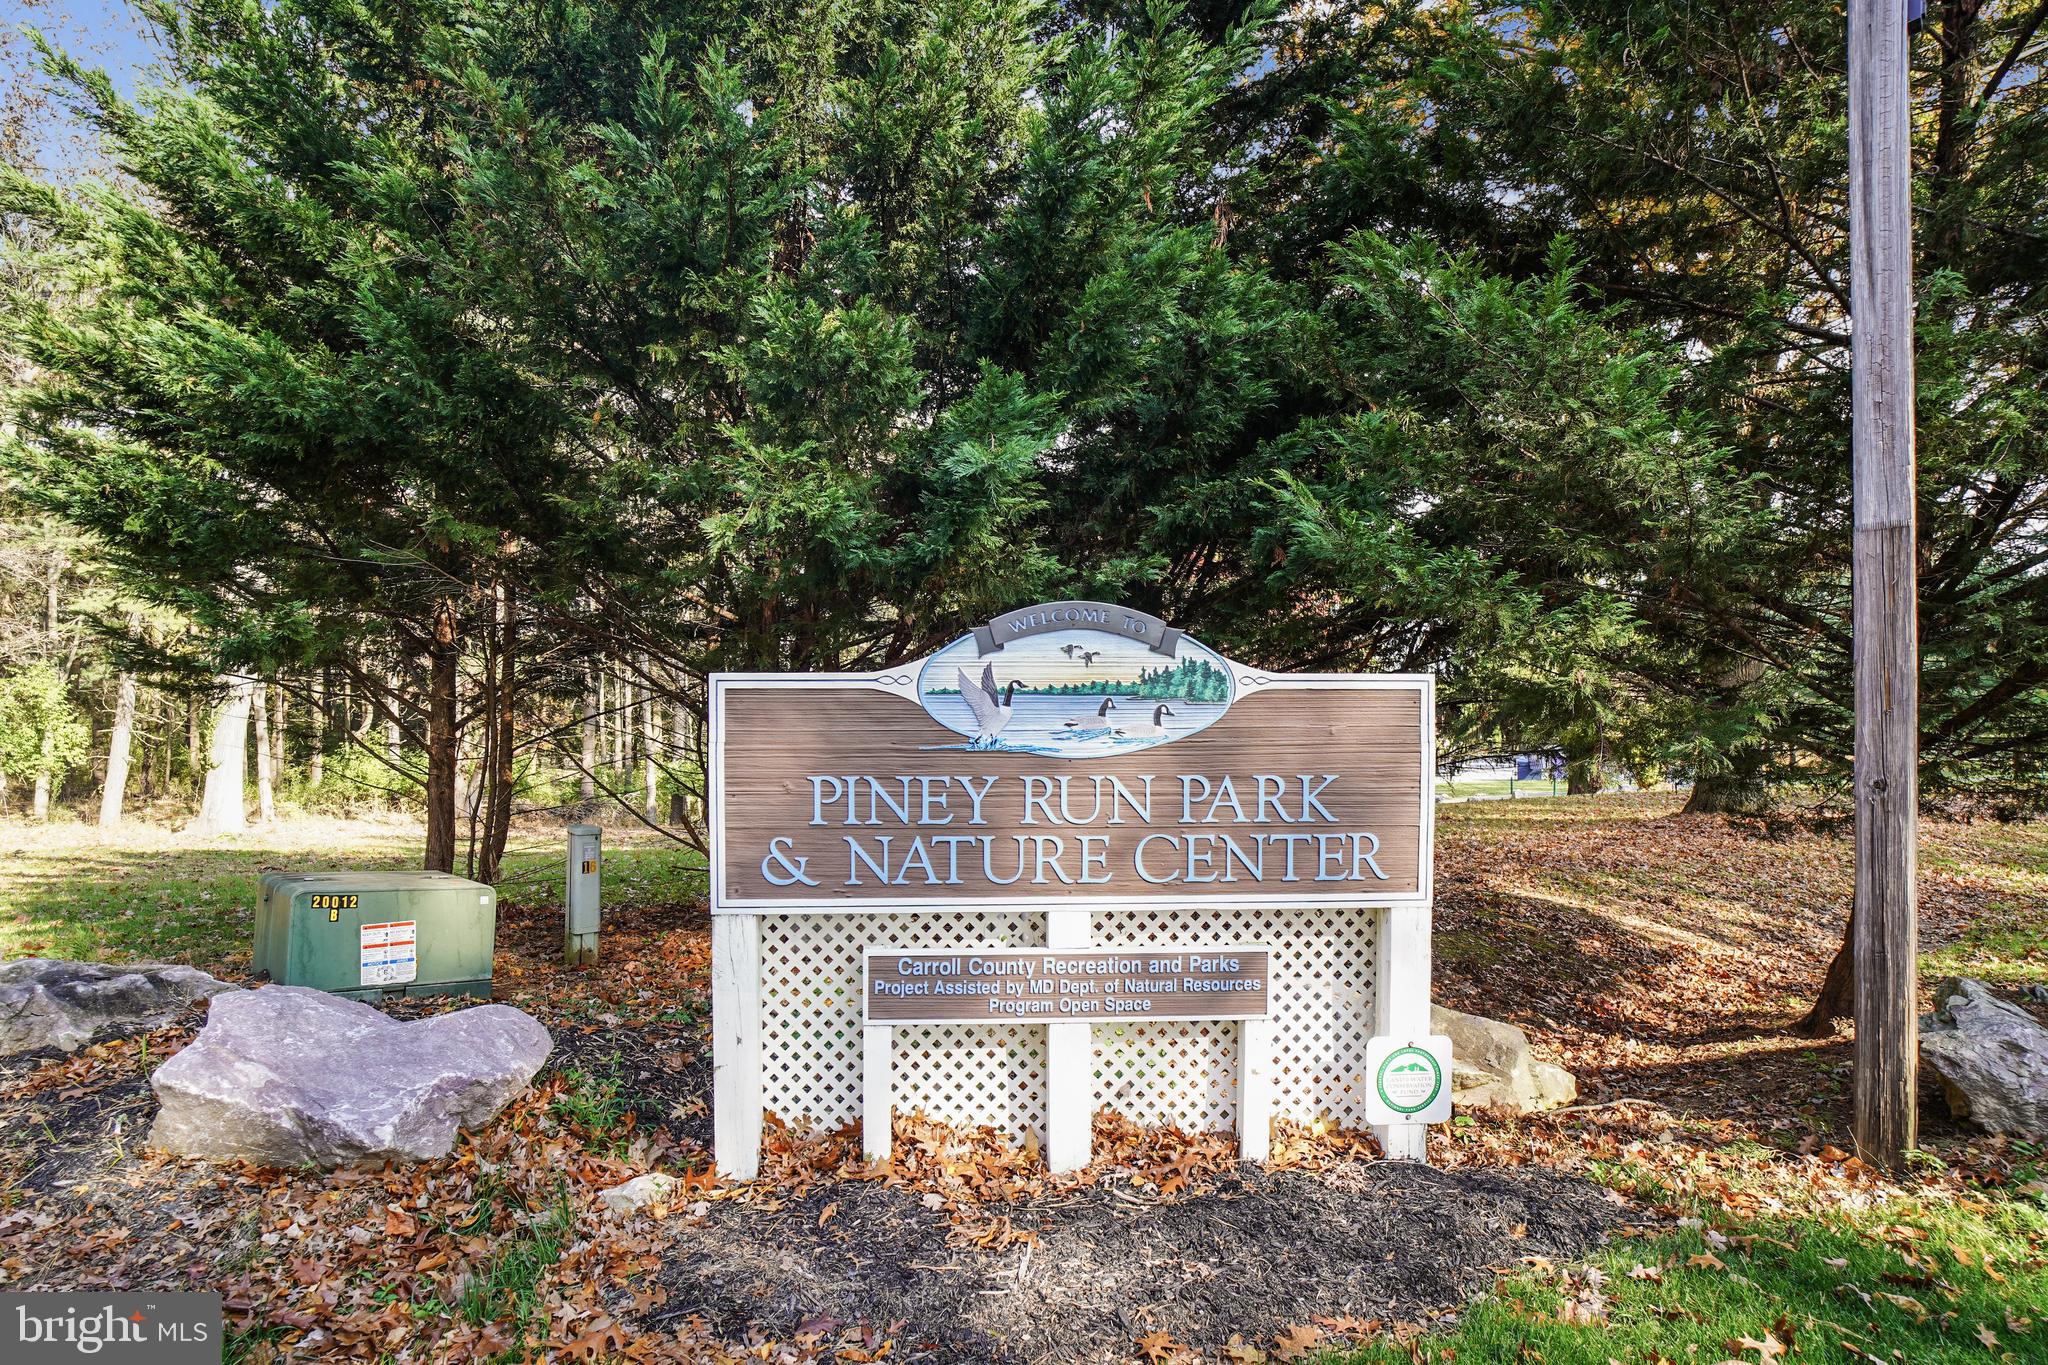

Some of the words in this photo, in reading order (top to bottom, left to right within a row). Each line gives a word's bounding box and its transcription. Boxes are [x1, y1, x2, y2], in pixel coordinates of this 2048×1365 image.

[1008, 608, 1111, 633] WELCOME
[1122, 615, 1147, 634] TO
[805, 775, 1000, 825] PINEY
[1019, 775, 1156, 825] RUN
[1176, 774, 1340, 824] PARK
[583, 861, 597, 874] 16
[760, 836, 822, 887] &
[842, 834, 1113, 886] NATURE
[1133, 832, 1390, 884] CENTER
[312, 895, 358, 908] 20012
[330, 908, 338, 922] B
[897, 957, 961, 976] Carroll
[968, 957, 1036, 979] County
[1042, 956, 1142, 975] Recreation
[1149, 956, 1183, 974] and
[1189, 955, 1240, 973] Parks
[874, 980, 929, 998] Project
[933, 980, 1000, 995] Assisted
[1005, 980, 1024, 998] by
[1029, 980, 1056, 995] MD
[1059, 979, 1099, 997] Dept.
[1104, 978, 1119, 994] of
[1124, 978, 1177, 993] Natural
[1183, 977, 1262, 993] Resources
[988, 998, 1053, 1017] Program
[1059, 998, 1100, 1015] Open
[1104, 998, 1151, 1015] Space
